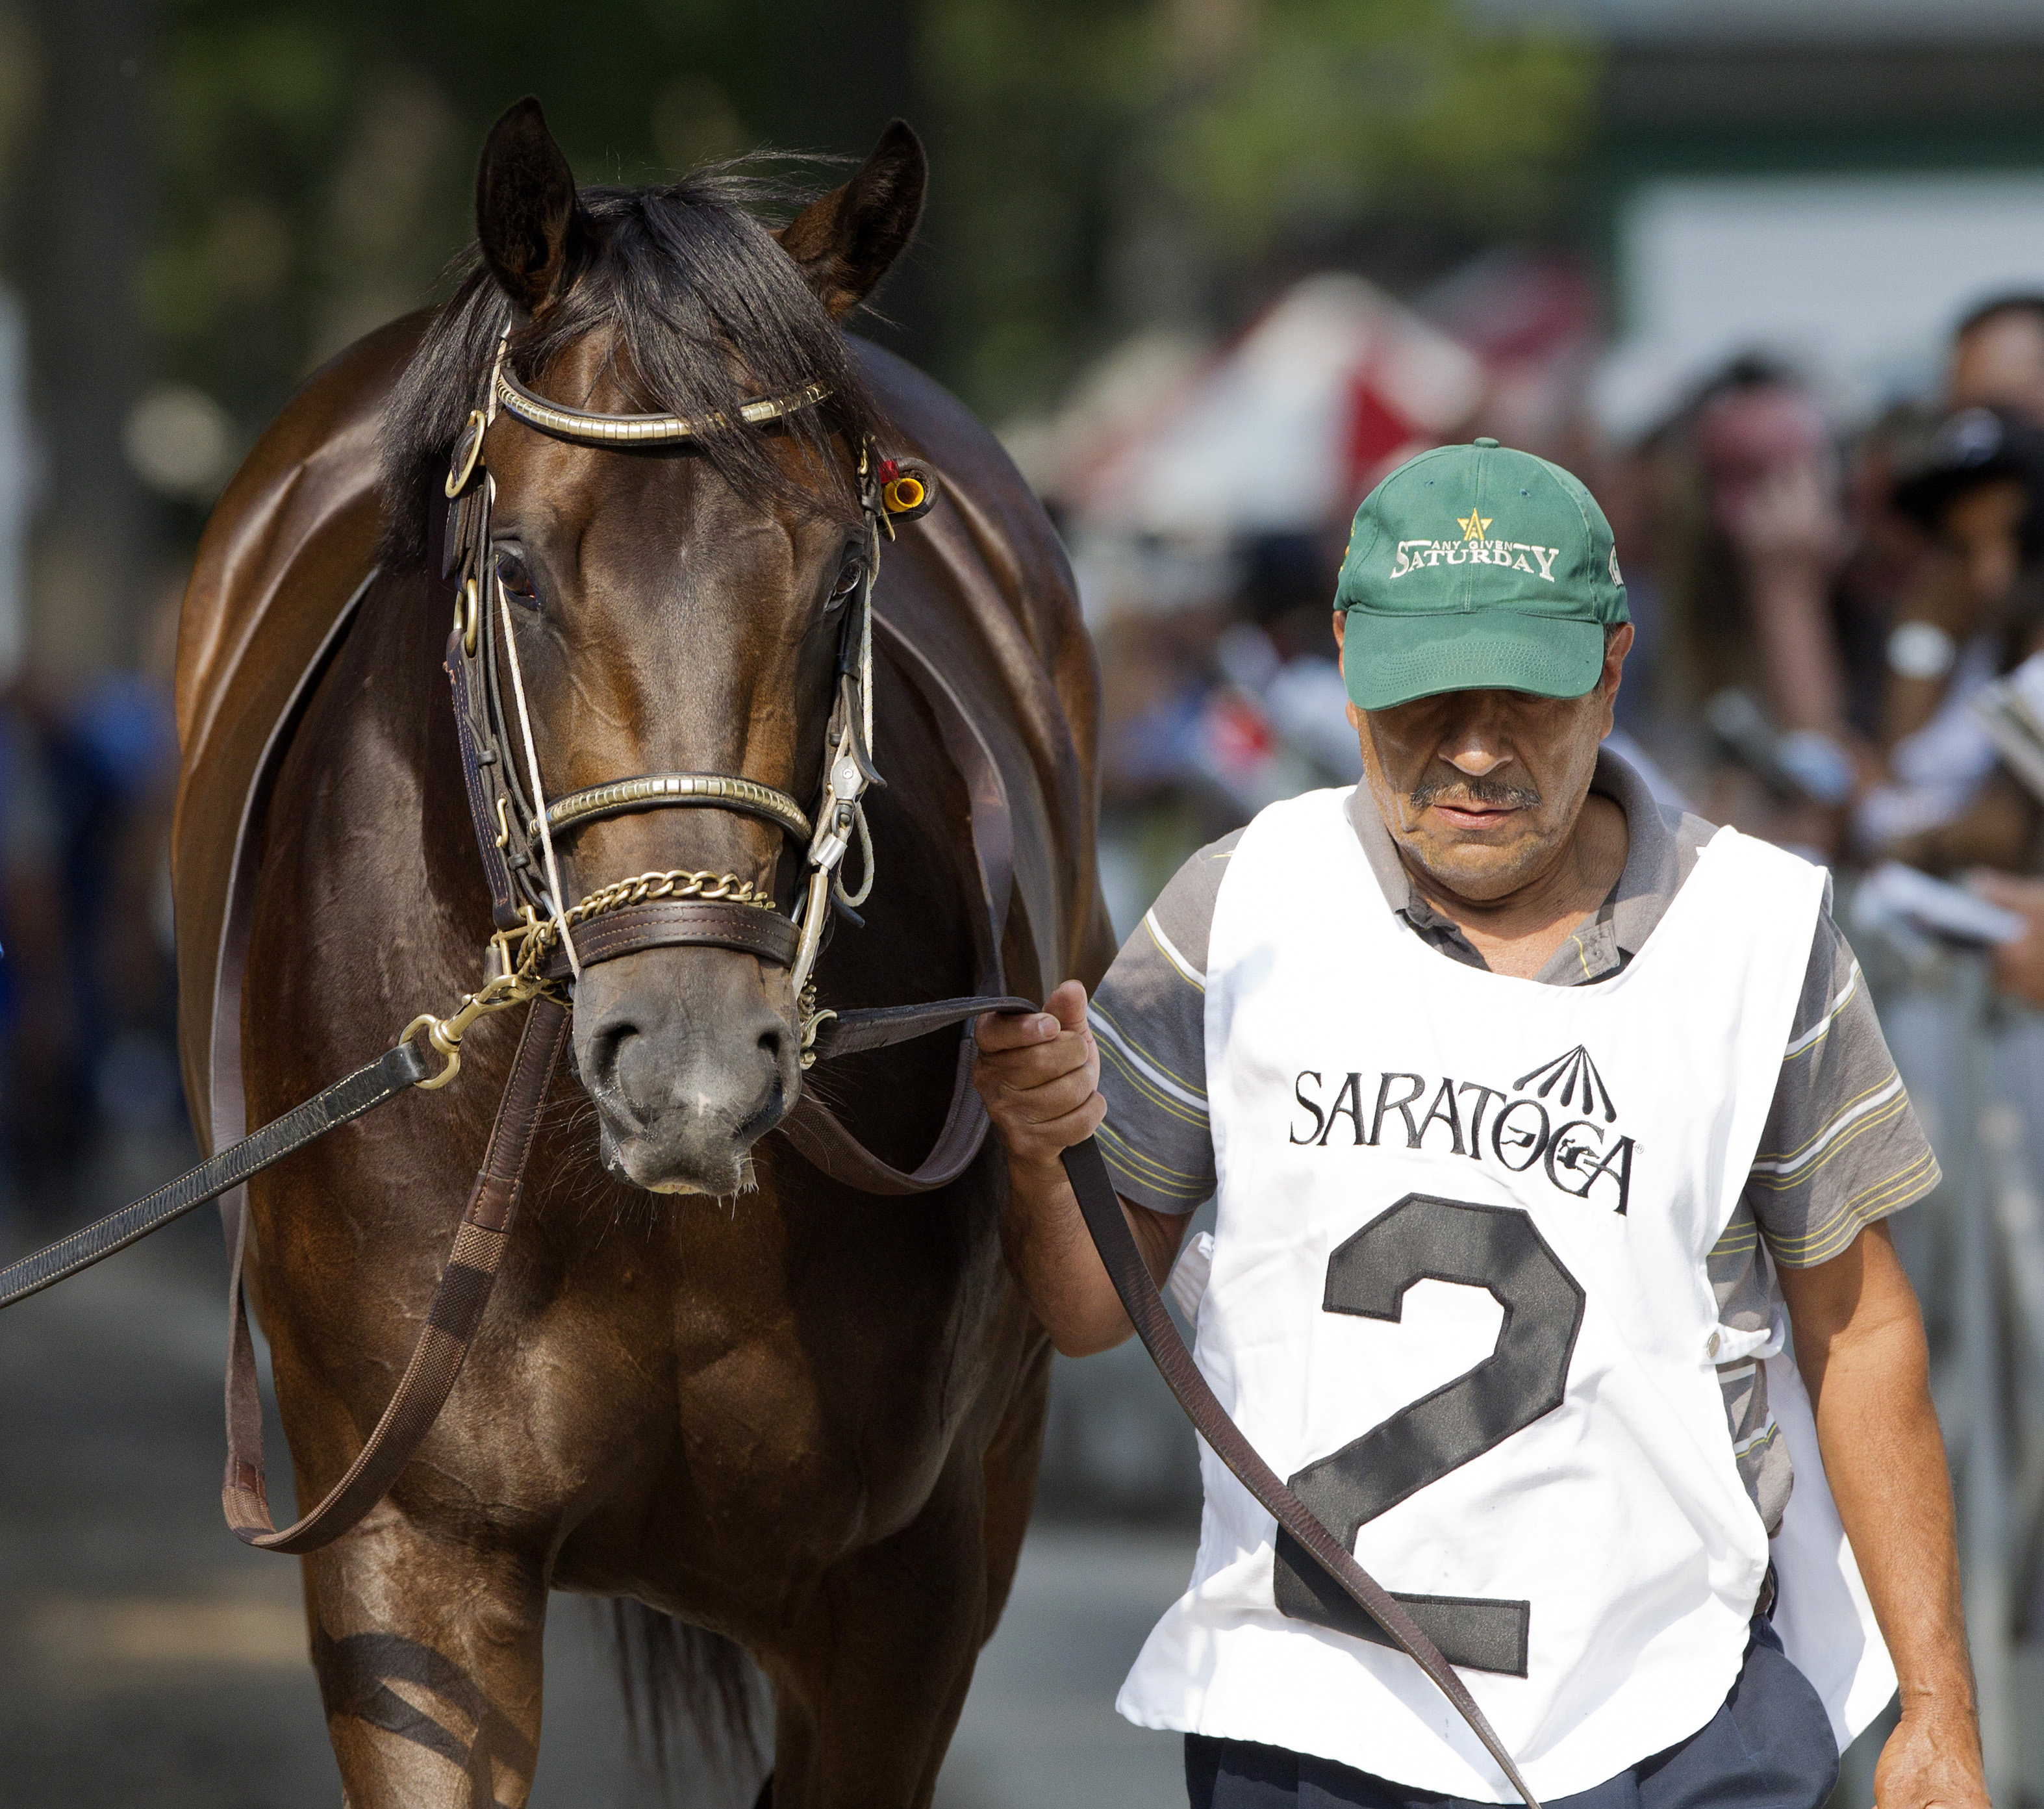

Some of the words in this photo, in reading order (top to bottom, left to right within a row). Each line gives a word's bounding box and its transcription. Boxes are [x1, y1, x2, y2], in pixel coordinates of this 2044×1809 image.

[1389, 540, 1559, 583] SATURDAY
[1431, 540, 1461, 550] ANY
[1469, 540, 1513, 551] GIVEN
[1289, 1070, 1636, 1217] SARATOGA
[1273, 1192, 1586, 1678] 2
